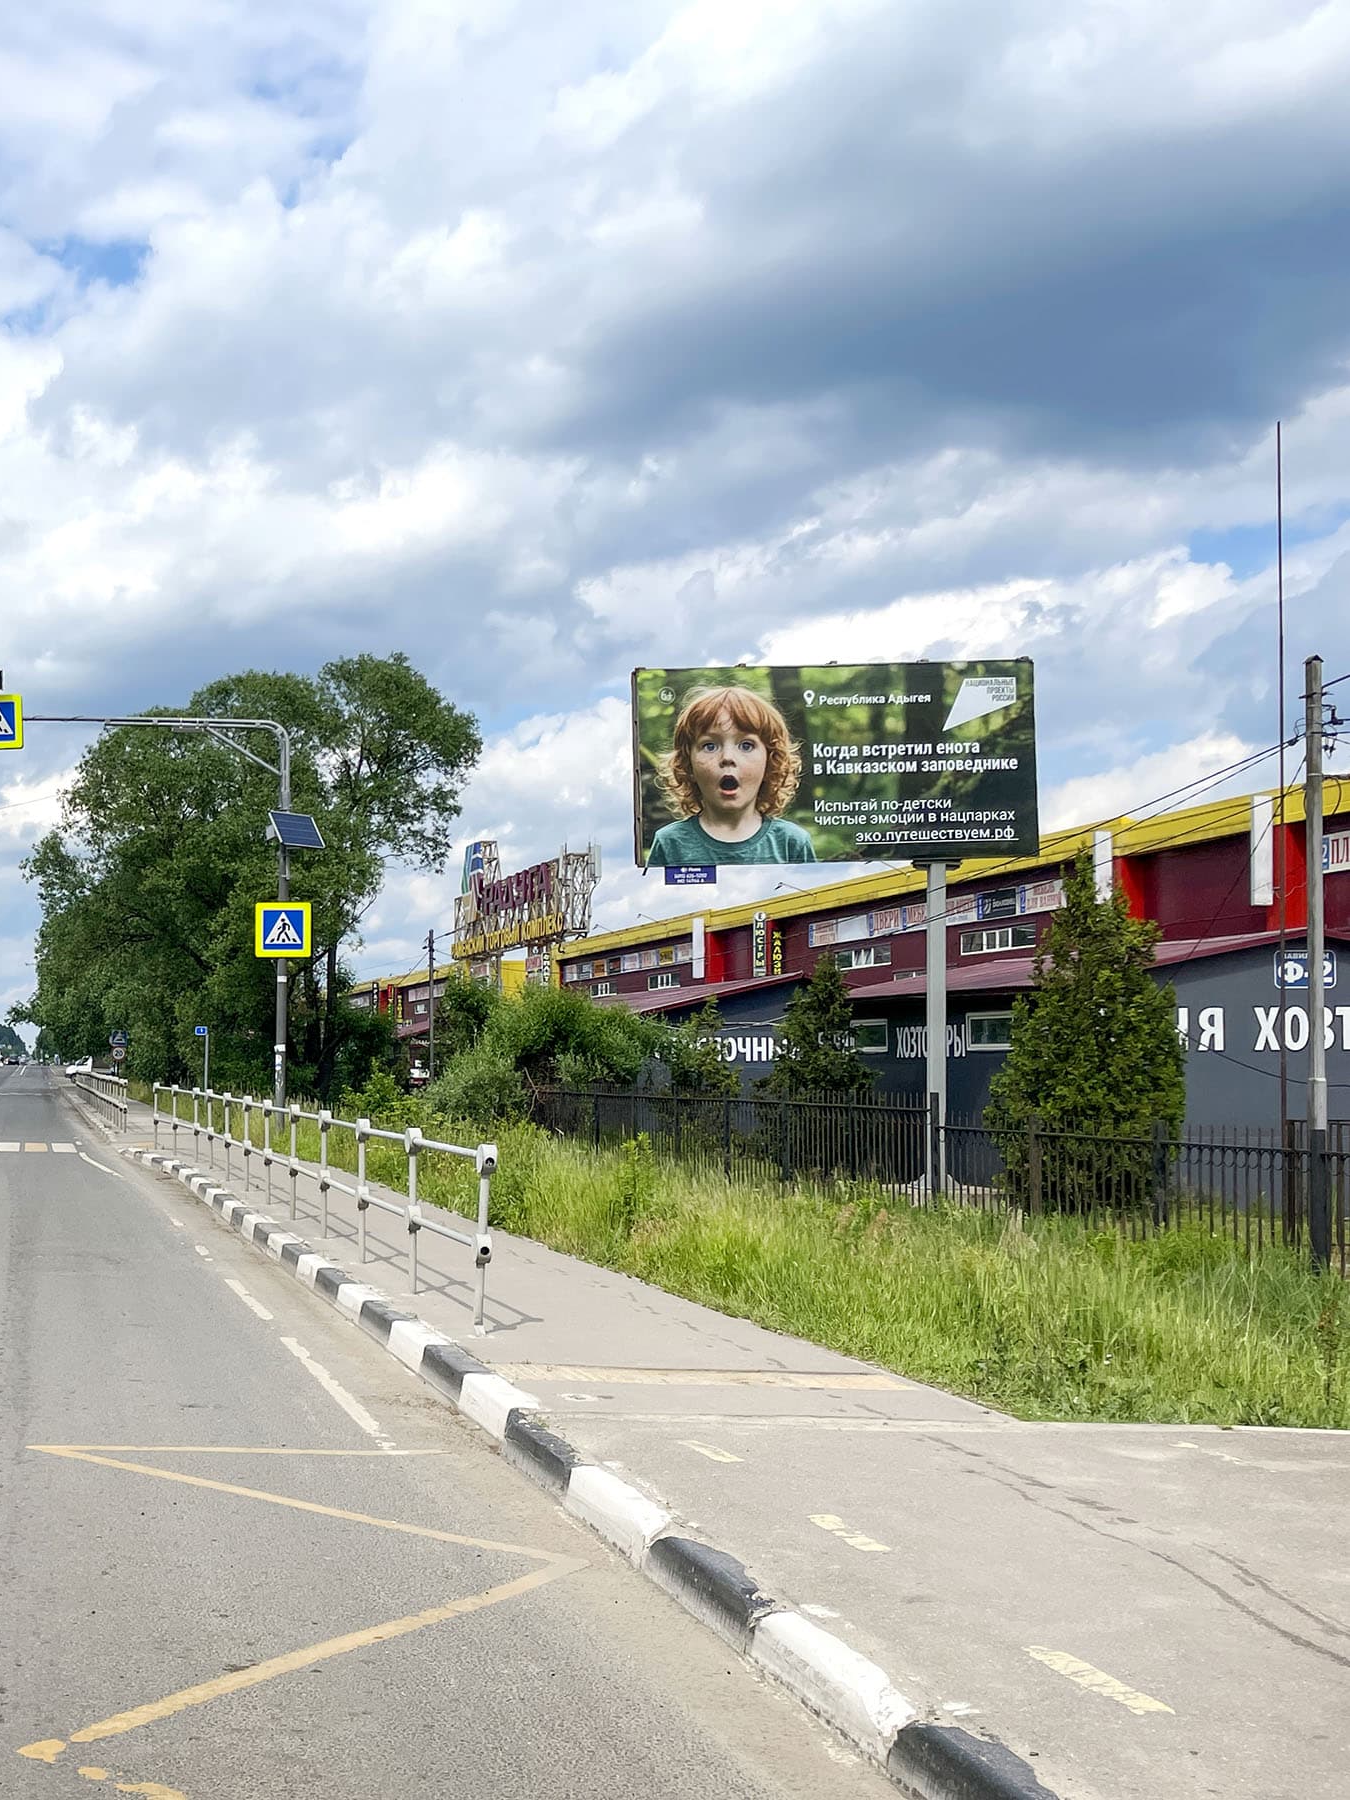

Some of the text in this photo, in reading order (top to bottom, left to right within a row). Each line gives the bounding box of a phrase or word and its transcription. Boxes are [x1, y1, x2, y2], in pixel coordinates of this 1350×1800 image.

[660, 689, 673, 702] 6+
[987, 686, 1014, 694] ПРОЕКТЫ
[991, 694, 1014, 702] РОССИИ
[818, 693, 931, 707] Республика Адыгея
[813, 741, 980, 759] Когда встретил енота
[813, 757, 1019, 775] в Кавказском заповеднике
[814, 797, 952, 812] Испытай по-детски
[814, 809, 1016, 826] чистые эмоции в нацпарках
[856, 825, 1015, 842] эко.путешествуем.рф
[483, 862, 551, 915] РАДУГА
[874, 909, 900, 930] ДВЕРИ
[755, 922, 765, 967] ЛЮСТРЫ
[772, 931, 782, 975] ЖАЛЮЗИ
[896, 1024, 966, 1058] ХОЗТОРЫ
